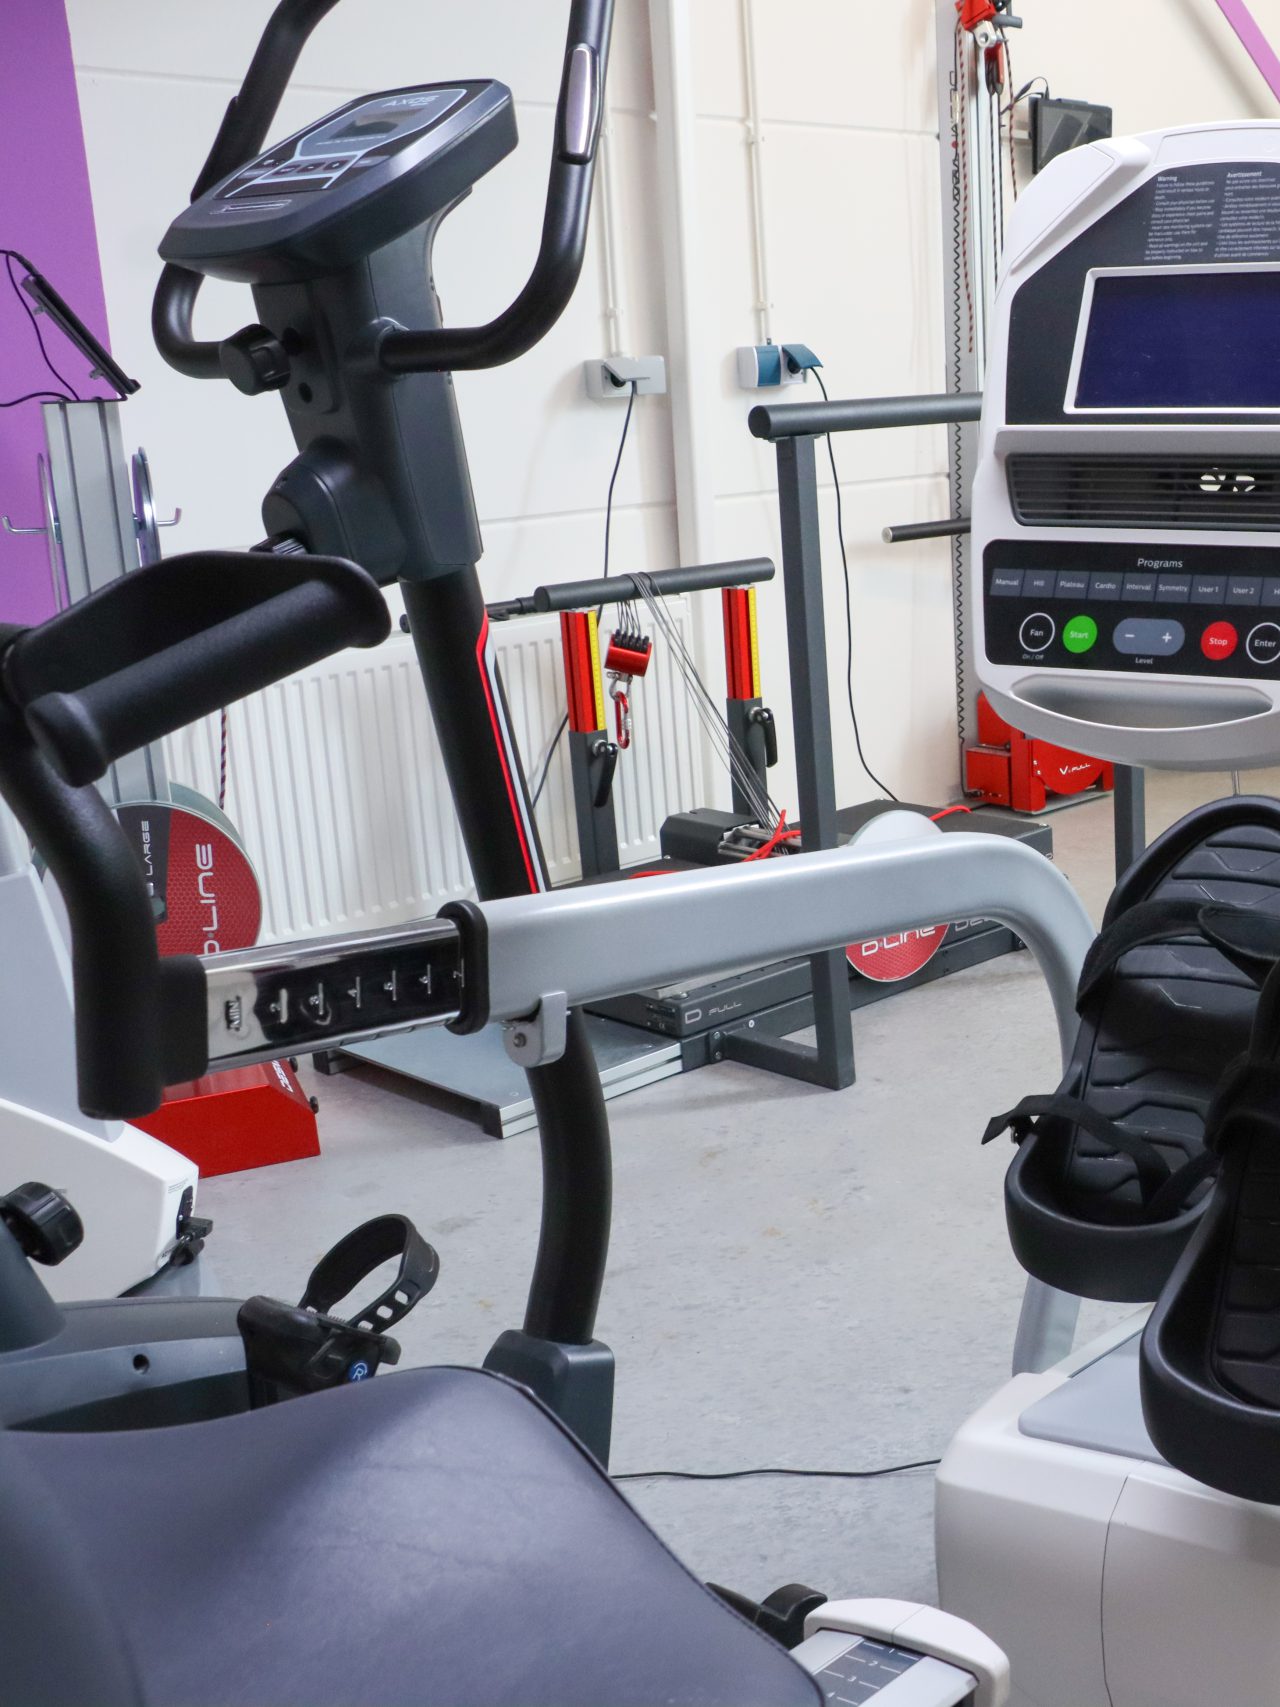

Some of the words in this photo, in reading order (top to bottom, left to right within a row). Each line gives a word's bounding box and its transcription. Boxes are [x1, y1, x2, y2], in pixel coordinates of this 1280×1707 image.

[382, 95, 440, 107] AXOS
[1137, 557, 1184, 569] Programs
[995, 578, 1019, 586] Manual
[1059, 580, 1085, 589] Plateau
[1095, 582, 1116, 590] Cardio
[1126, 583, 1152, 591] Interval
[1158, 584, 1188, 593] Symmetry
[1248, 587, 1254, 595] 2
[1030, 629, 1044, 637] Fan
[1069, 631, 1089, 639] Start
[1209, 637, 1228, 646] Stop
[1254, 639, 1276, 648] Enter
[1135, 657, 1153, 665] Level
[141, 820, 153, 876] LARGE
[685, 1009, 702, 1024] D
